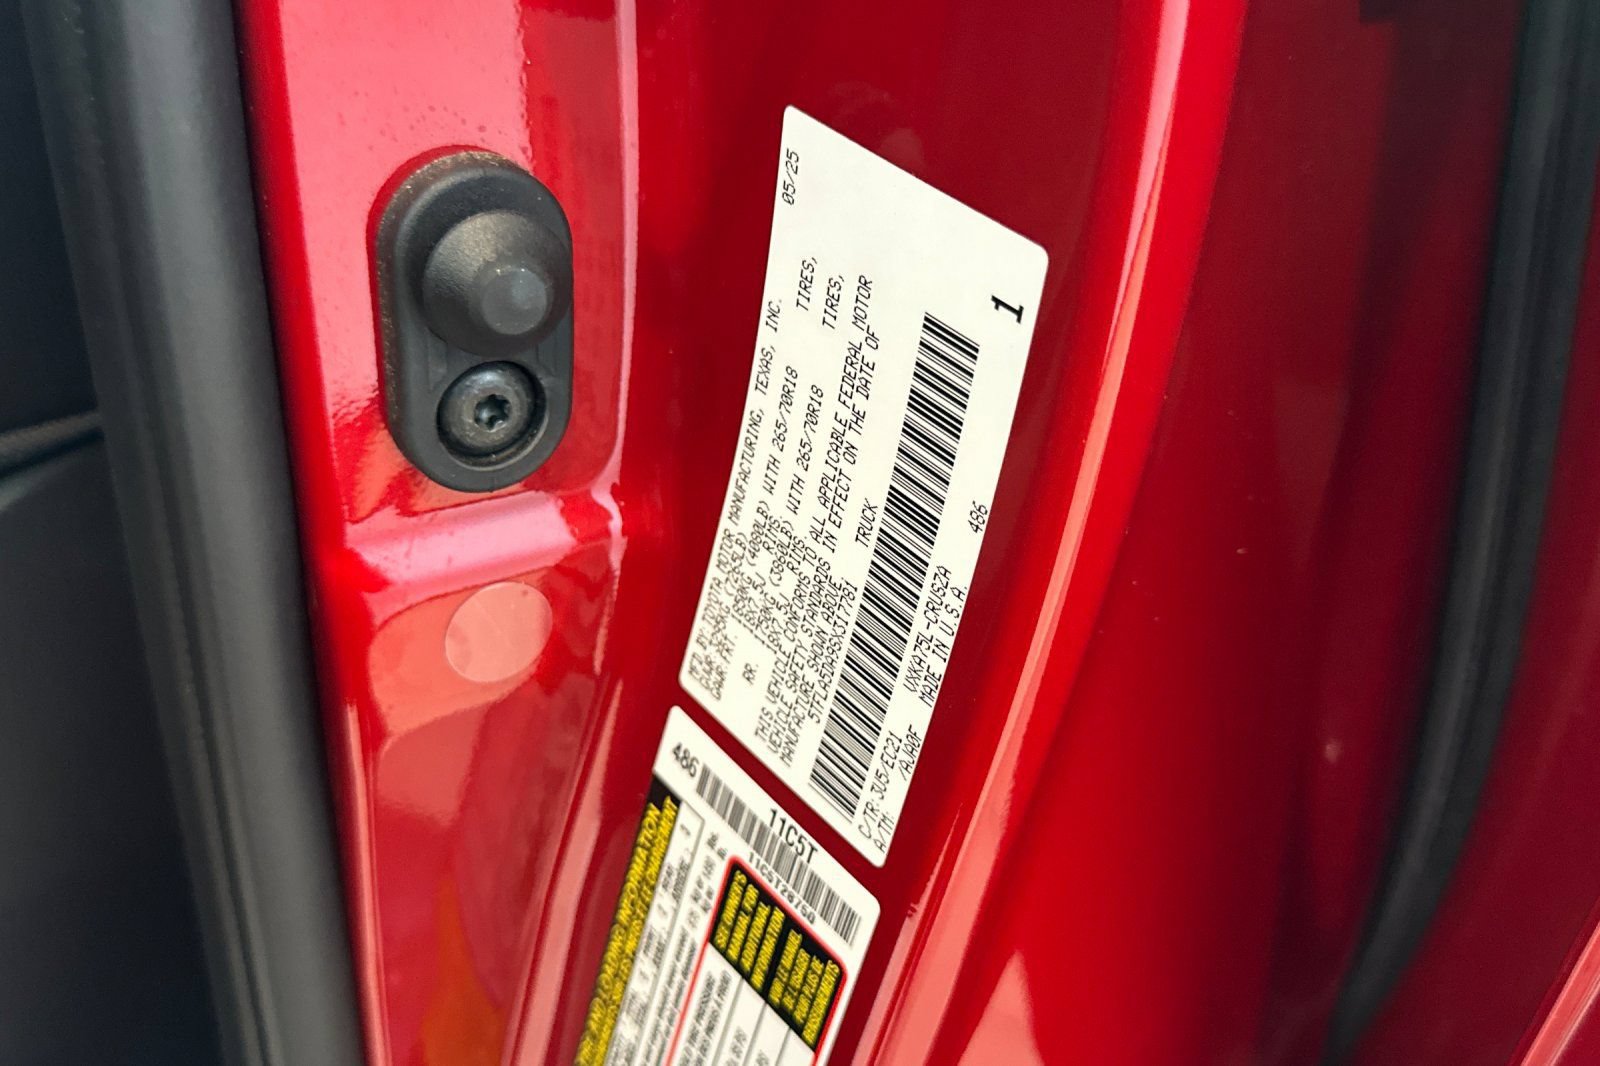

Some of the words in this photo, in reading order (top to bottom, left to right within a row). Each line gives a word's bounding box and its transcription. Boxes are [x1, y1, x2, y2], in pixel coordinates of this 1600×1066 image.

[782, 148, 799, 205] 05/25
[851, 275, 873, 332] MOTOR
[991, 295, 1024, 324] 1
[864, 324, 880, 350] OF
[838, 341, 862, 409] FEDERAL
[855, 355, 876, 400] DATE
[731, 572, 753, 624] 1850KG
[746, 500, 769, 567] (4080LB)
[762, 454, 780, 496] WITH
[772, 365, 798, 452] 265/70R18
[796, 257, 817, 311] TIRES,
[848, 403, 866, 436] THE
[701, 577, 723, 626] TOYOTA
[715, 528, 735, 574] MOTOR
[727, 409, 764, 526] MANUFACTURING,
[754, 345, 776, 395] TEXAS,
[765, 296, 781, 333] INC.
[742, 660, 758, 685] RR.
[754, 592, 776, 645] 1750KG
[769, 520, 794, 587] (3860LB)
[786, 473, 805, 515] WITH
[796, 384, 823, 472] 265/70R18
[822, 275, 844, 329] TIRES,
[817, 411, 848, 510] APPLICABLE
[842, 440, 858, 465] ON
[828, 468, 852, 529] EFFECT
[968, 500, 988, 533] 486
[762, 512, 782, 555] RIMS.
[786, 532, 807, 575] RIMS.
[802, 546, 817, 567] TO
[809, 516, 826, 544] ALL
[822, 530, 838, 554] IN
[724, 532, 748, 596] (7265LB)
[783, 571, 811, 643] CONFORMS
[800, 557, 831, 638] STANDARDS
[807, 580, 858, 724] 5TFLA5DA9SX317781
[855, 497, 878, 548] TRUCK
[939, 580, 967, 637] U.S.A.
[903, 565, 952, 692] VXKA75L-CRUSZA
[931, 638, 950, 663] IN
[766, 644, 791, 704] VEHICLE
[779, 674, 815, 767] MANUFACTURE
[806, 625, 829, 673] SHOWN
[820, 572, 844, 625] ABOVE.
[785, 639, 808, 693] SAFETY
[918, 664, 942, 708] MADE
[754, 707, 773, 742] THIS
[767, 694, 793, 754] VEHICLE
[672, 743, 699, 778] 486
[769, 809, 818, 864] 11C5T
[873, 812, 894, 853] A/TM:
[725, 907, 750, 964] MANUAL
[741, 881, 759, 914] FOR
[739, 895, 771, 974] ADDITIONAL
[749, 904, 786, 992] INFORMATION
